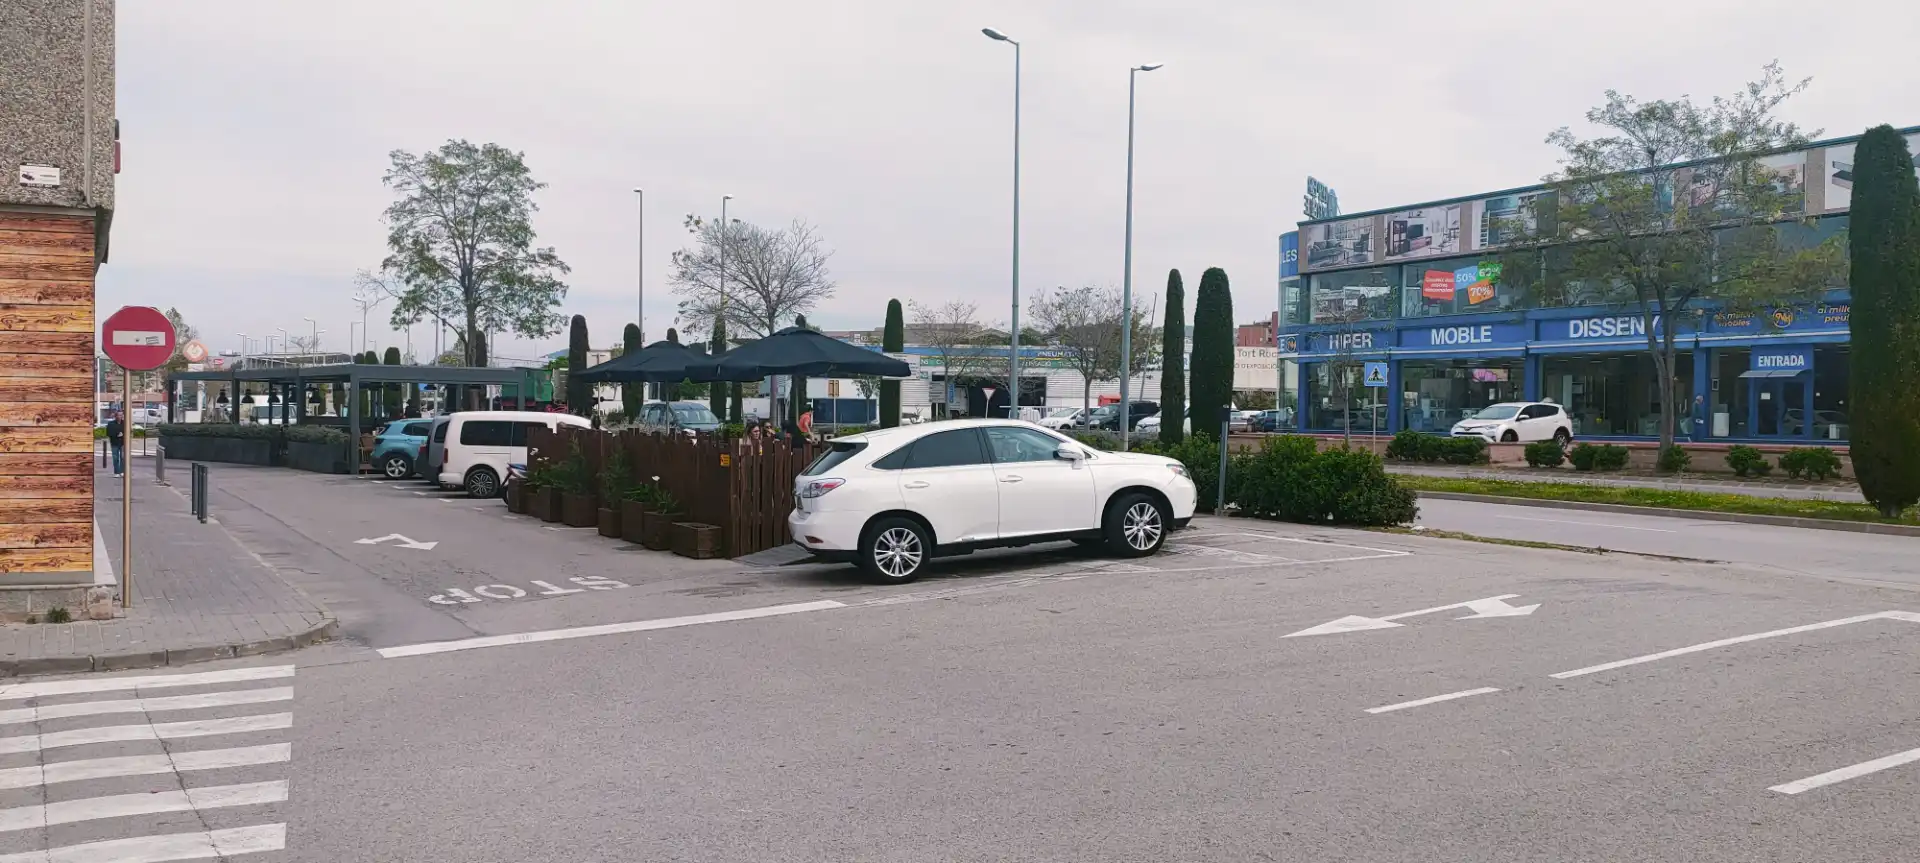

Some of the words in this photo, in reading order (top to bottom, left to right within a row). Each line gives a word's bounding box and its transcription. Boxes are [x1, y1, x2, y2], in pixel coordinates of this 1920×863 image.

[1456, 271, 1477, 283] 50%
[1470, 285, 1492, 297] 70%
[1828, 305, 1850, 314] millo
[1328, 332, 1373, 350] HIPER
[1430, 325, 1492, 346] MOBLE
[1236, 349, 1256, 359] Tort
[1757, 354, 1805, 368] ENTRADA
[428, 575, 630, 605] STOP
